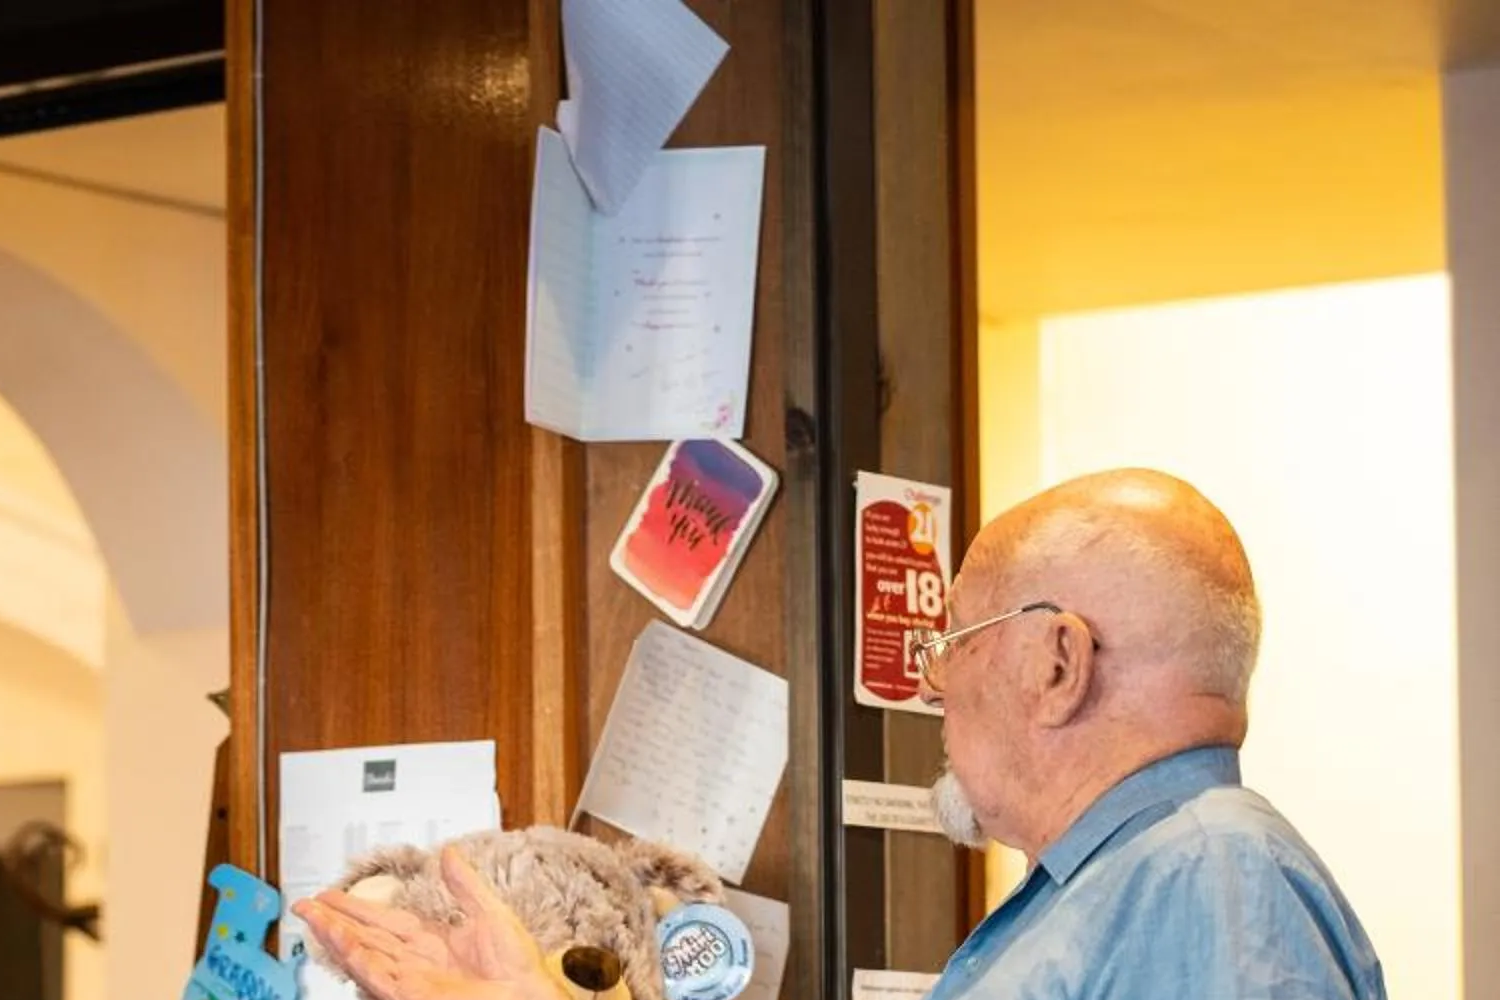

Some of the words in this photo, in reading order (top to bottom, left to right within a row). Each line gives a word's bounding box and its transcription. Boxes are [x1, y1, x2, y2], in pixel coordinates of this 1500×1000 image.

[666, 480, 731, 546] Thank
[876, 579, 905, 596] over
[904, 567, 943, 618] 18
